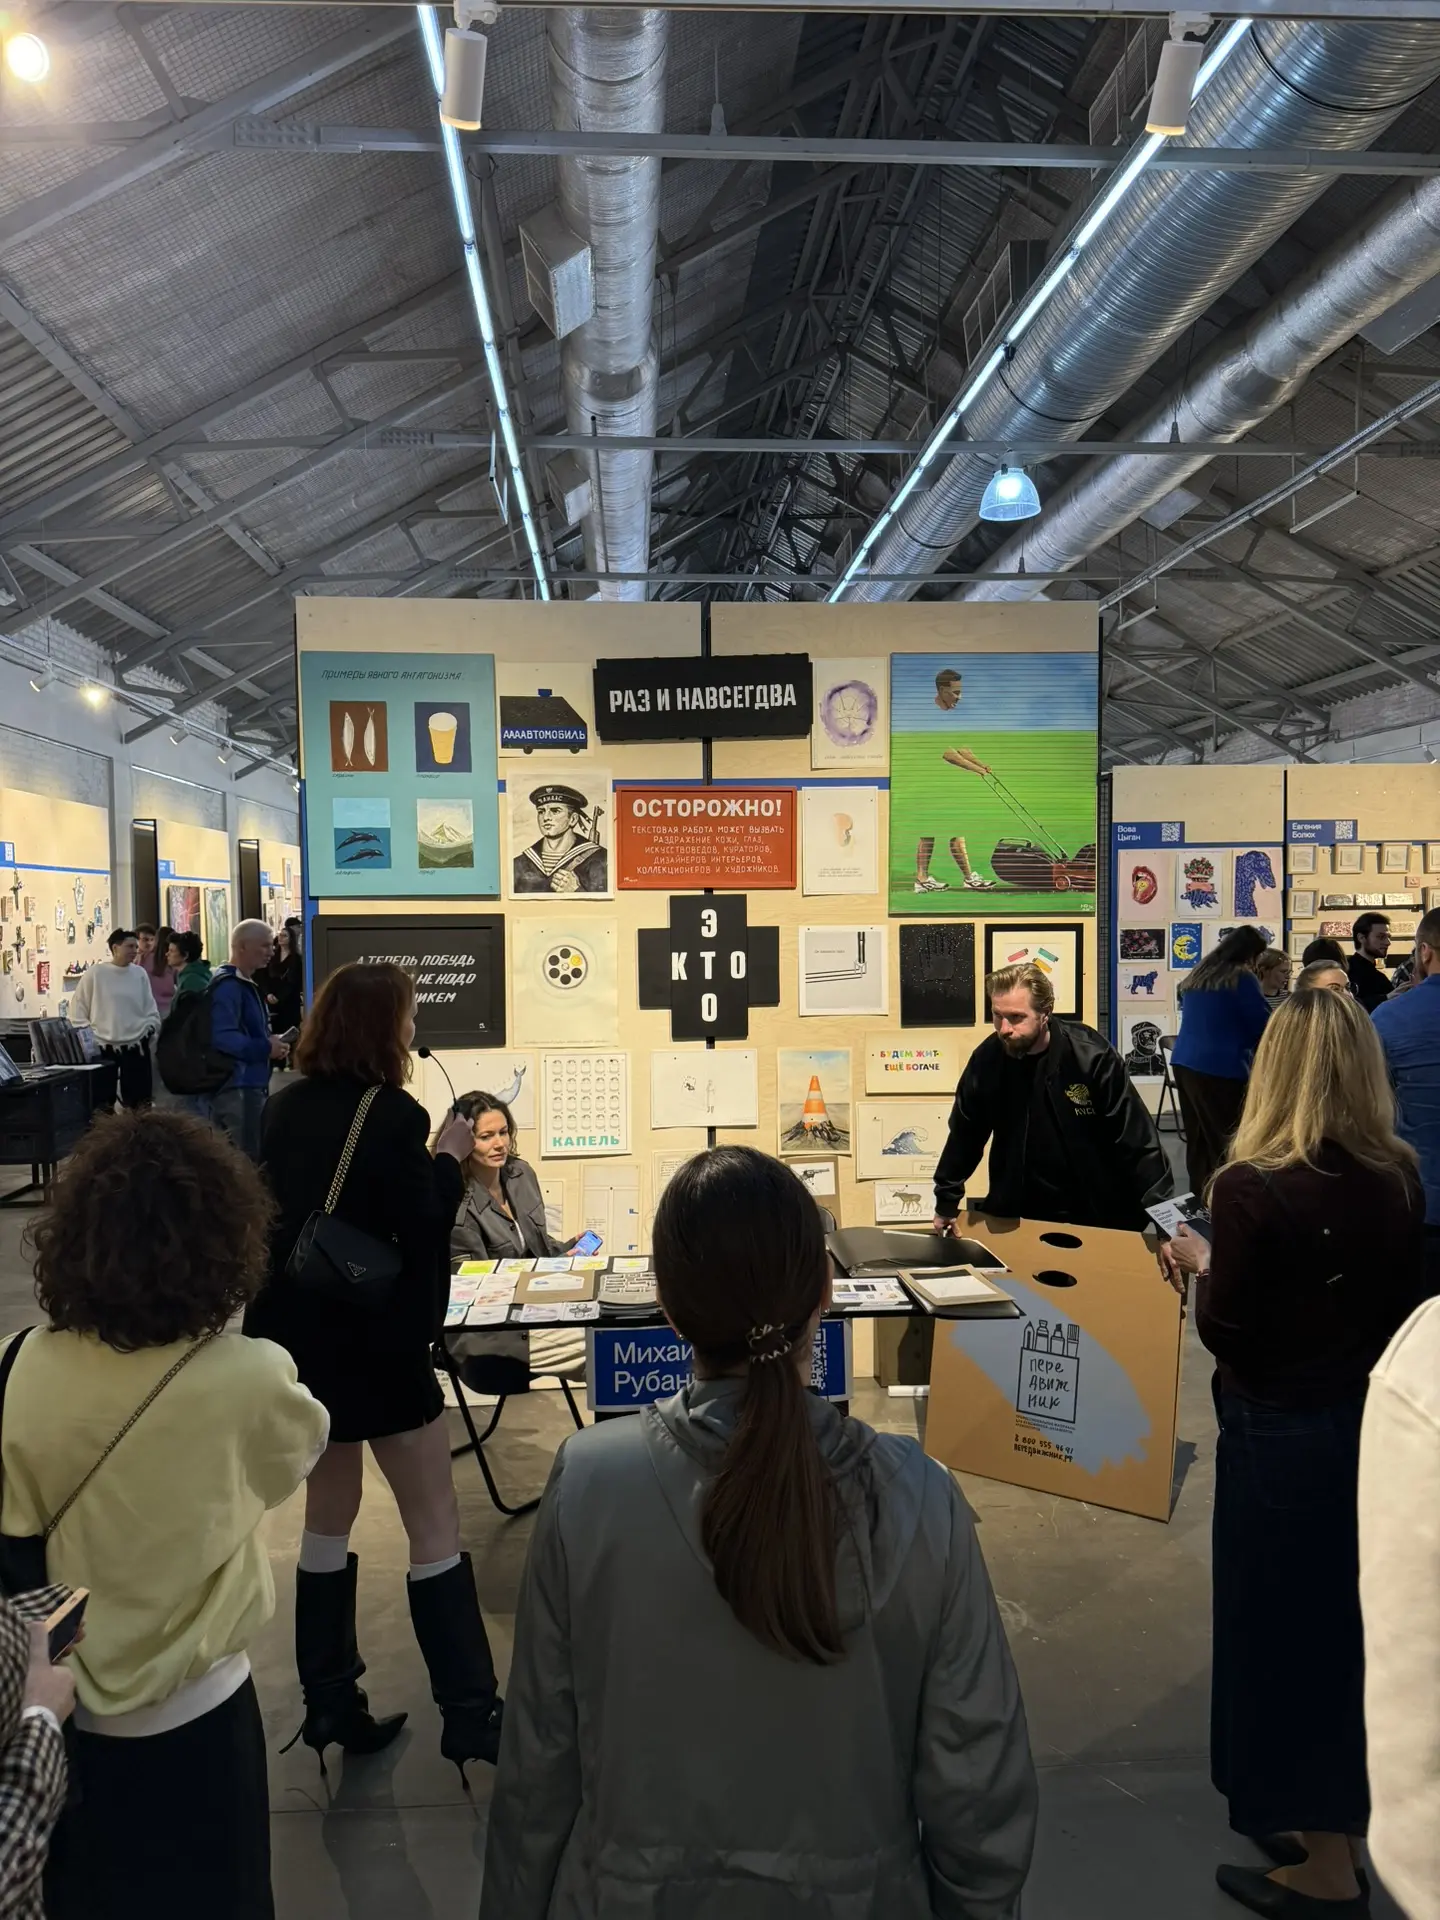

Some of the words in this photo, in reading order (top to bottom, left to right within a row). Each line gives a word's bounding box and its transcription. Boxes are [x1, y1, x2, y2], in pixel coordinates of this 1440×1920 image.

[367, 670, 399, 679] ЯВНОГО
[609, 688, 651, 713] РАЗ
[656, 687, 671, 711] И
[676, 683, 797, 710] НАВСЕГДВА
[503, 729, 586, 741] ААААВТОМОБИЛЬ
[632, 798, 782, 817] ОСТОРОЖНО!
[631, 825, 679, 834] ТЕКСТОВАЯ
[682, 825, 713, 834] РАБОТА
[717, 825, 745, 834] МОЖЕТ
[749, 825, 785, 834] ВЫЗВАТЬ
[1117, 825, 1137, 833] Вова
[1292, 822, 1322, 830] Евгения
[653, 835, 711, 844] РАЗДРАЖЕНИЕ
[715, 835, 740, 845] КОЖИ,
[743, 835, 764, 844] ГЛАЗ,
[1117, 833, 1141, 841] Цыган
[644, 846, 720, 855] ИСКУССТВОВЕДОВ,
[723, 846, 772, 854] КУРАТОРОВ,
[653, 855, 707, 865] ДИЗАЙНЕРОВ
[711, 855, 764, 864] ИНТЕРЬЕРОВ,
[636, 865, 711, 875] КОЛЛЕКЦИОНЕРОВ
[724, 865, 781, 874] ХУДОЖНИКОВ.
[356, 956, 364, 964] А
[420, 954, 476, 968] ПОБУДЬ
[416, 973, 436, 985] НЕ
[415, 992, 457, 1004] ИКЕМ
[880, 1050, 914, 1060] БУДЕМ
[884, 1062, 905, 1072] ЕЩЁ
[906, 1062, 941, 1071] БОГАЧЕ
[552, 1135, 620, 1147] КАПЕЛЬ
[1014, 1433, 1020, 1442] 8
[1022, 1437, 1036, 1445] 800
[1039, 1440, 1052, 1449] 555
[1014, 1443, 1074, 1463] ПЕРЕДВИЖНИК.РФ
